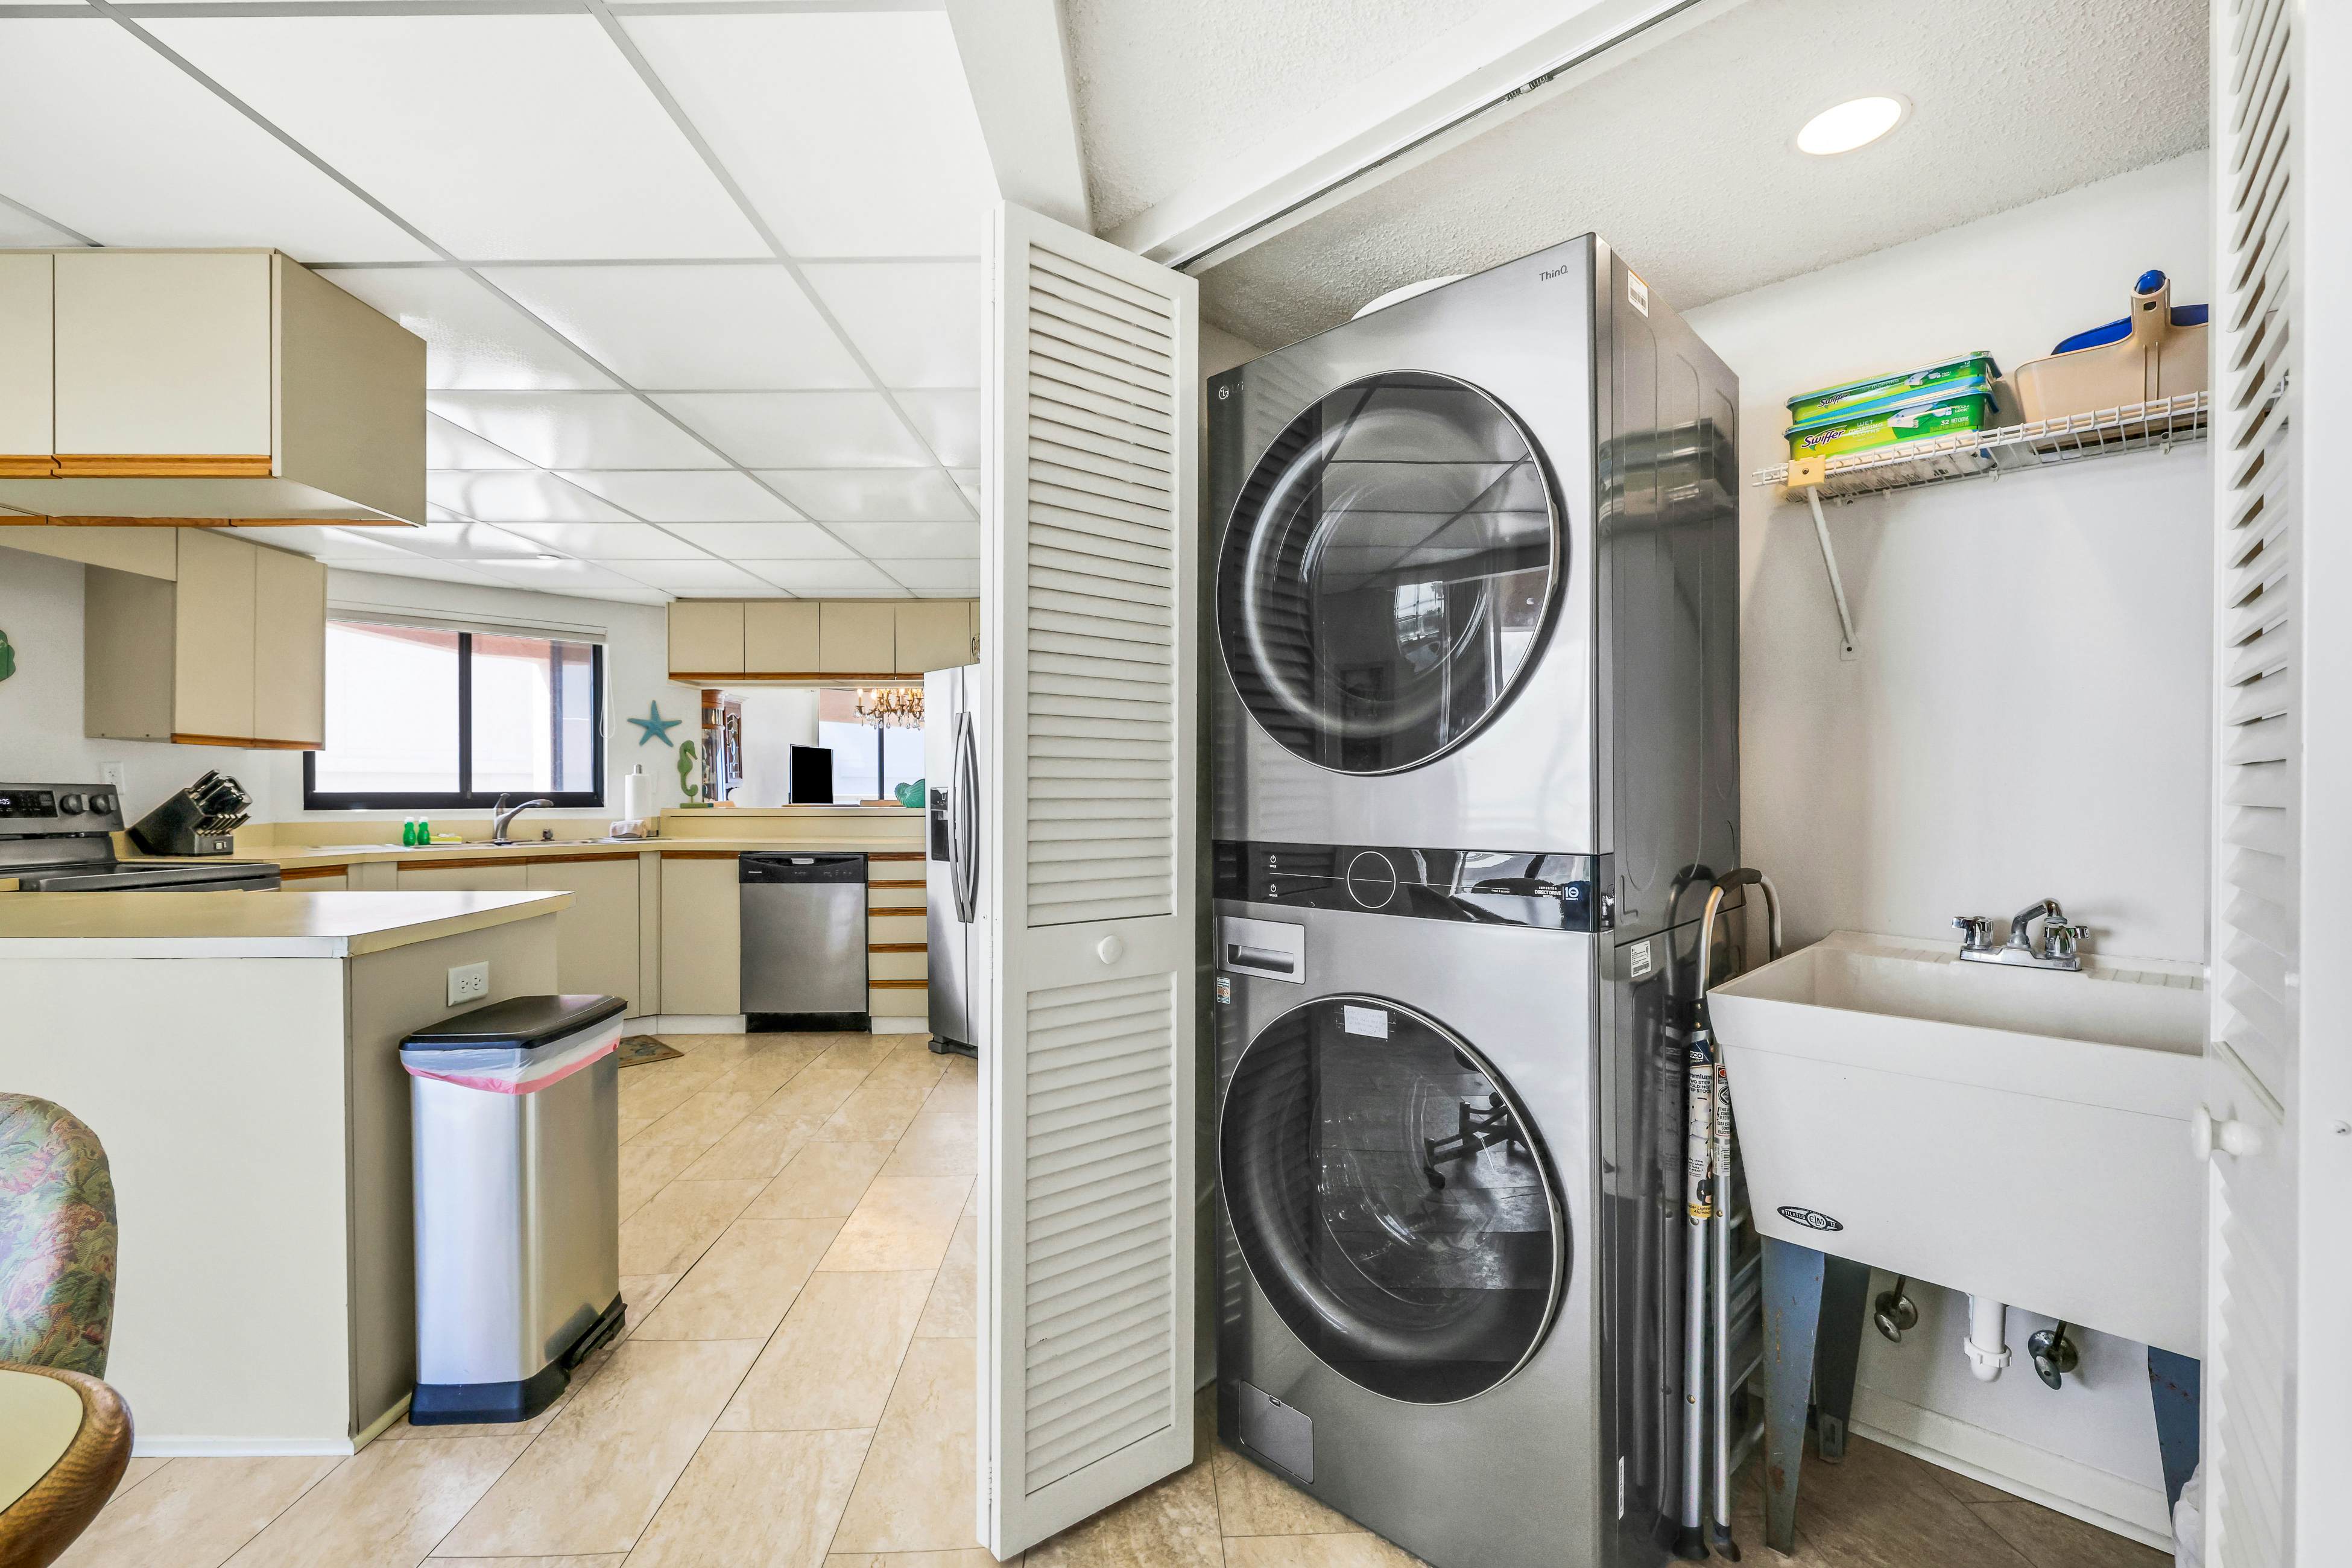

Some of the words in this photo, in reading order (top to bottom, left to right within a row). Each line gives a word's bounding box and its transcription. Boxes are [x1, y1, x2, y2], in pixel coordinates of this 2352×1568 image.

[1538, 265, 1569, 281] ThinQ
[1818, 393, 1850, 407] Swiffer
[1801, 430, 1844, 447] Swiffer
[1564, 887, 1579, 898] 10
[1781, 1209, 1806, 1219] UTILATUB
